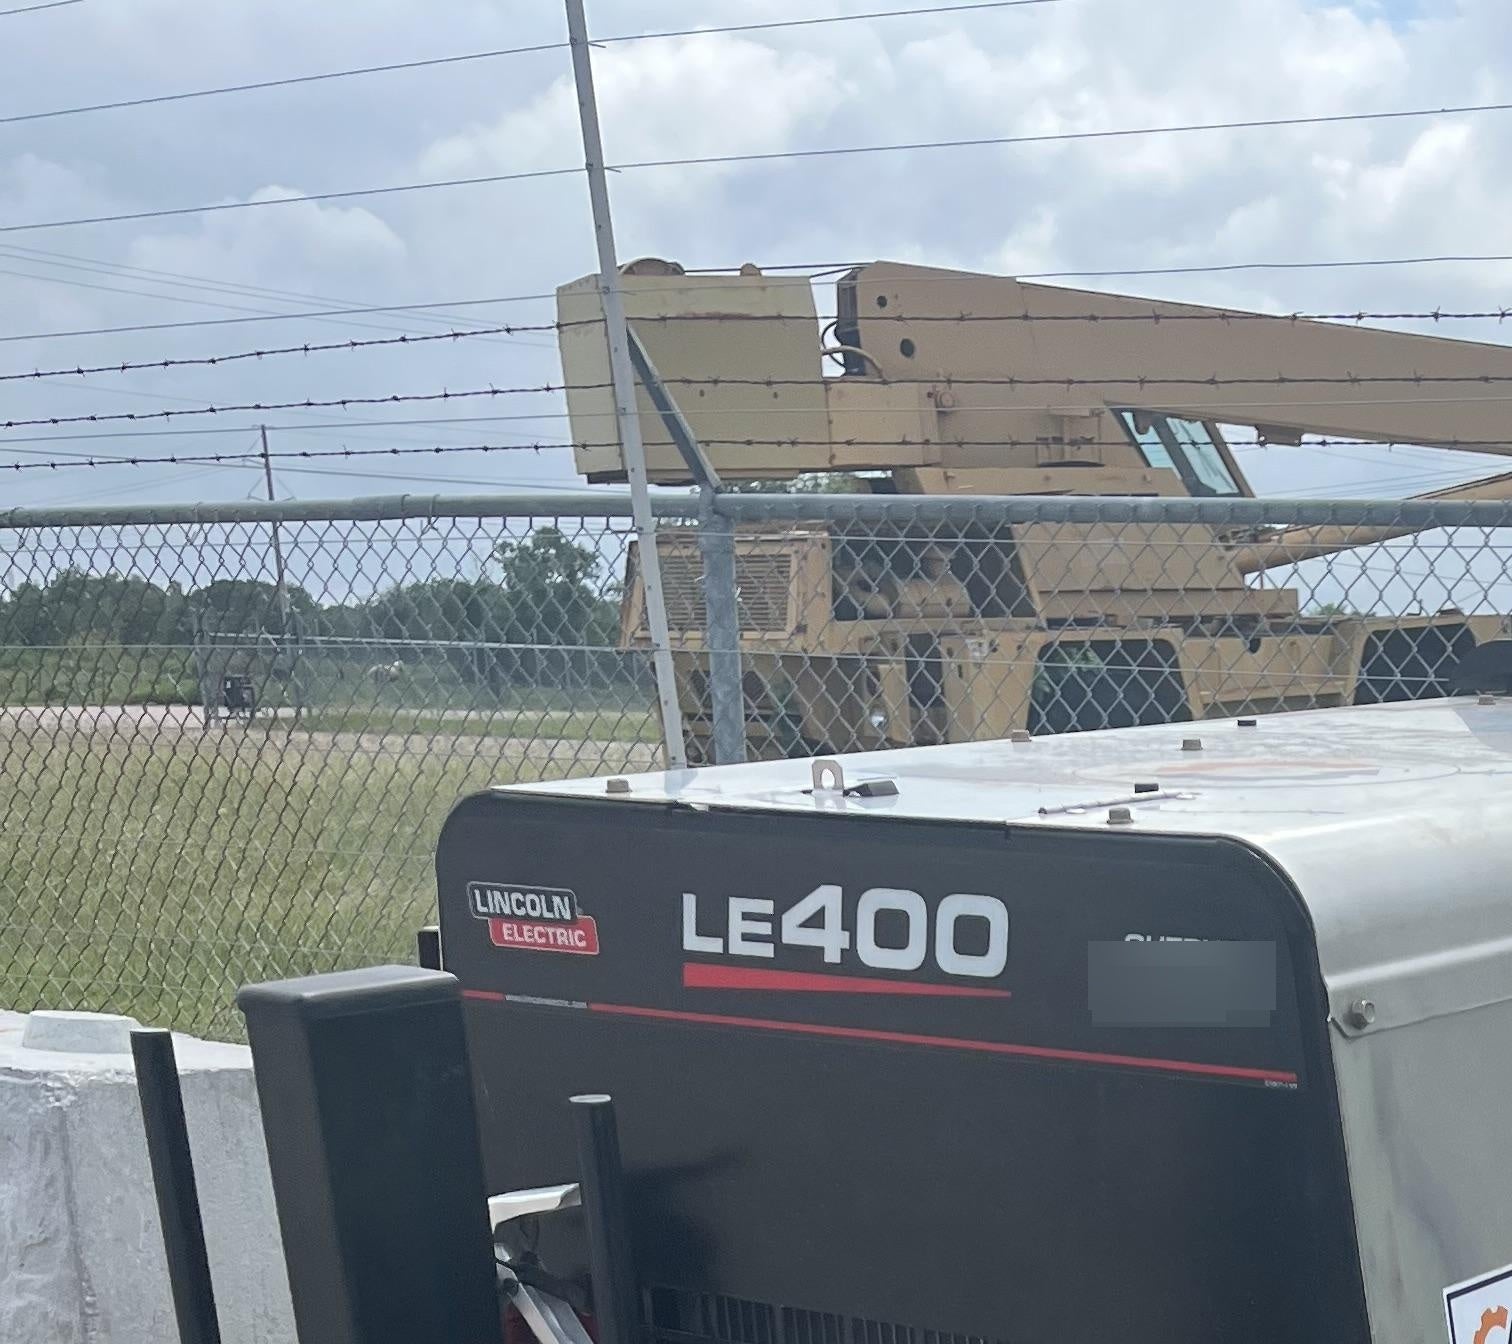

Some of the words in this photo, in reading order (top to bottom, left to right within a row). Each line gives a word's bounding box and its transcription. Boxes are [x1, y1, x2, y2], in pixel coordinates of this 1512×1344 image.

[474, 888, 571, 920] LINCOLN
[502, 922, 587, 947] ELECTRIC
[683, 884, 1009, 978] LE400
